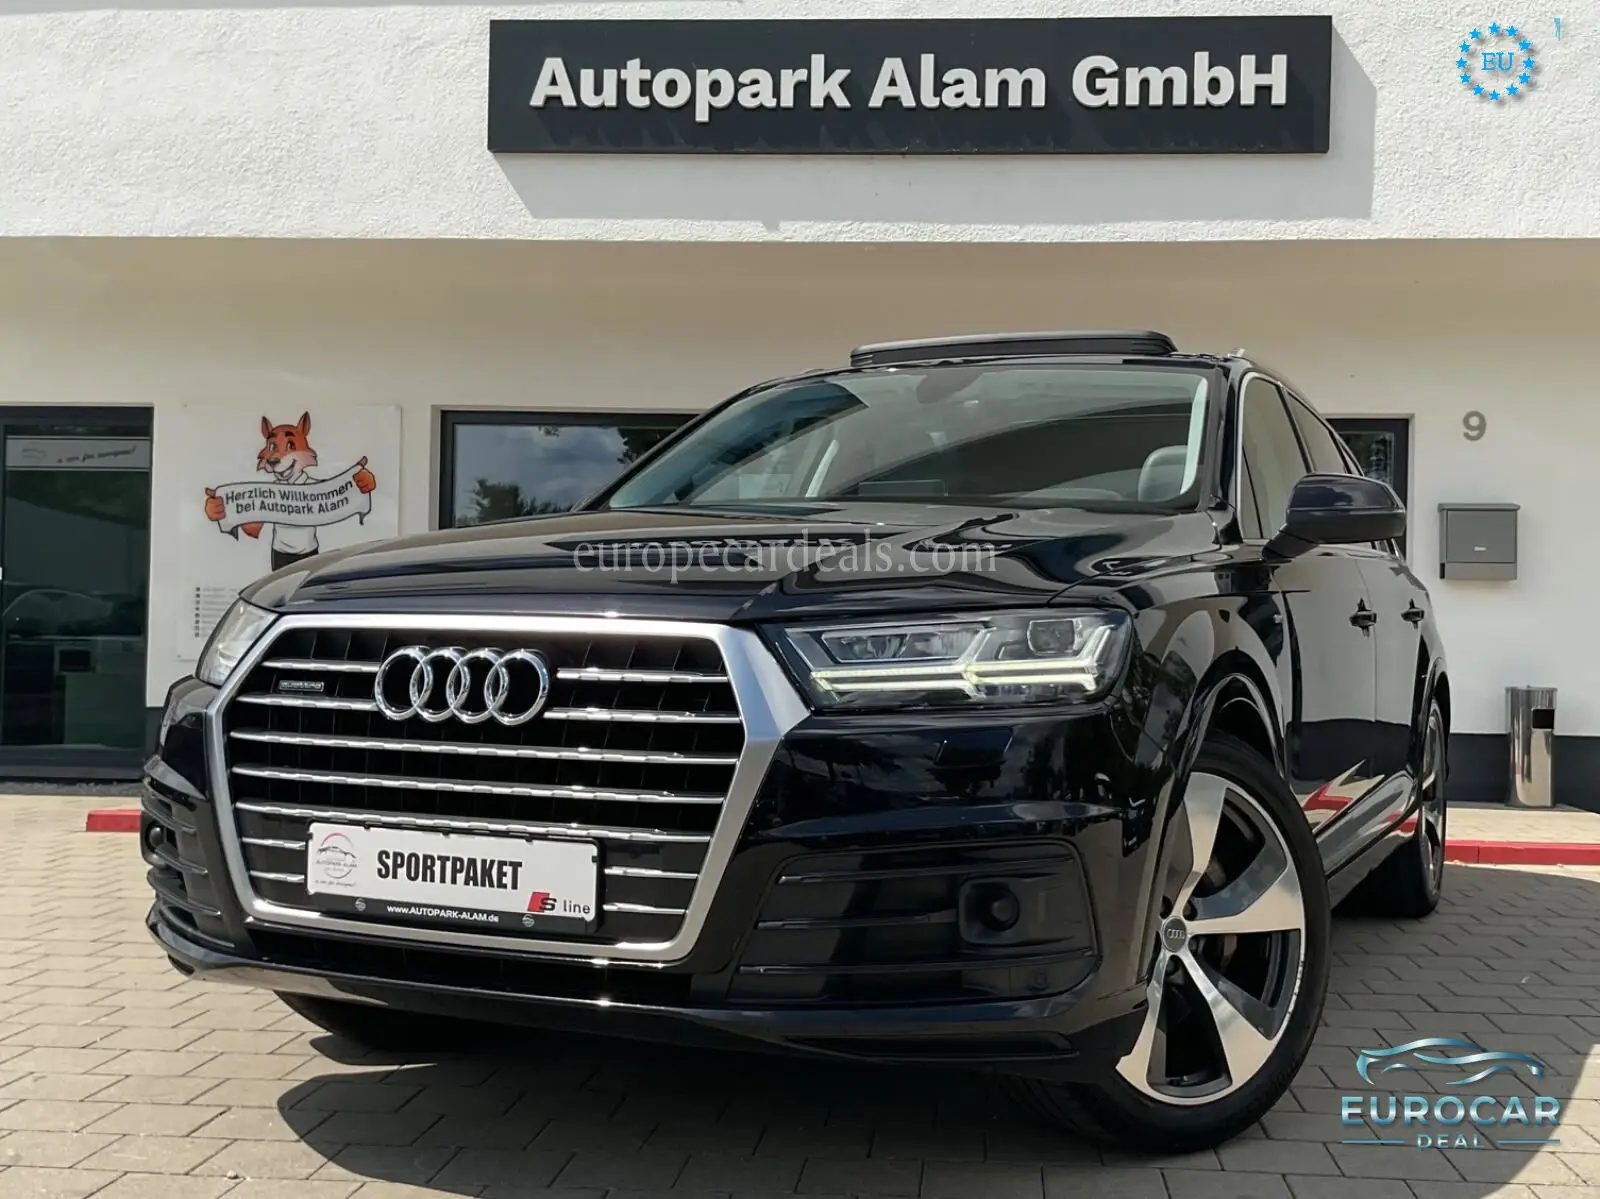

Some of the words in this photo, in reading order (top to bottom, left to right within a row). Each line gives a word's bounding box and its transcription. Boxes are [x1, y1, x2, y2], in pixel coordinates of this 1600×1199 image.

[530, 56, 851, 122] Autopark
[868, 54, 1047, 109] Alam
[1072, 52, 1289, 108] GmbH
[1463, 411, 1486, 441] 9
[225, 488, 276, 505] Herzlich
[278, 480, 353, 504] Willkommen
[235, 502, 256, 515] bei
[258, 501, 314, 516] Autopark
[317, 496, 349, 515] Alam
[377, 850, 523, 890] SPORTPAKET
[386, 904, 500, 923] www.AUTOPARK-ALAM.de
[563, 900, 591, 914] line
